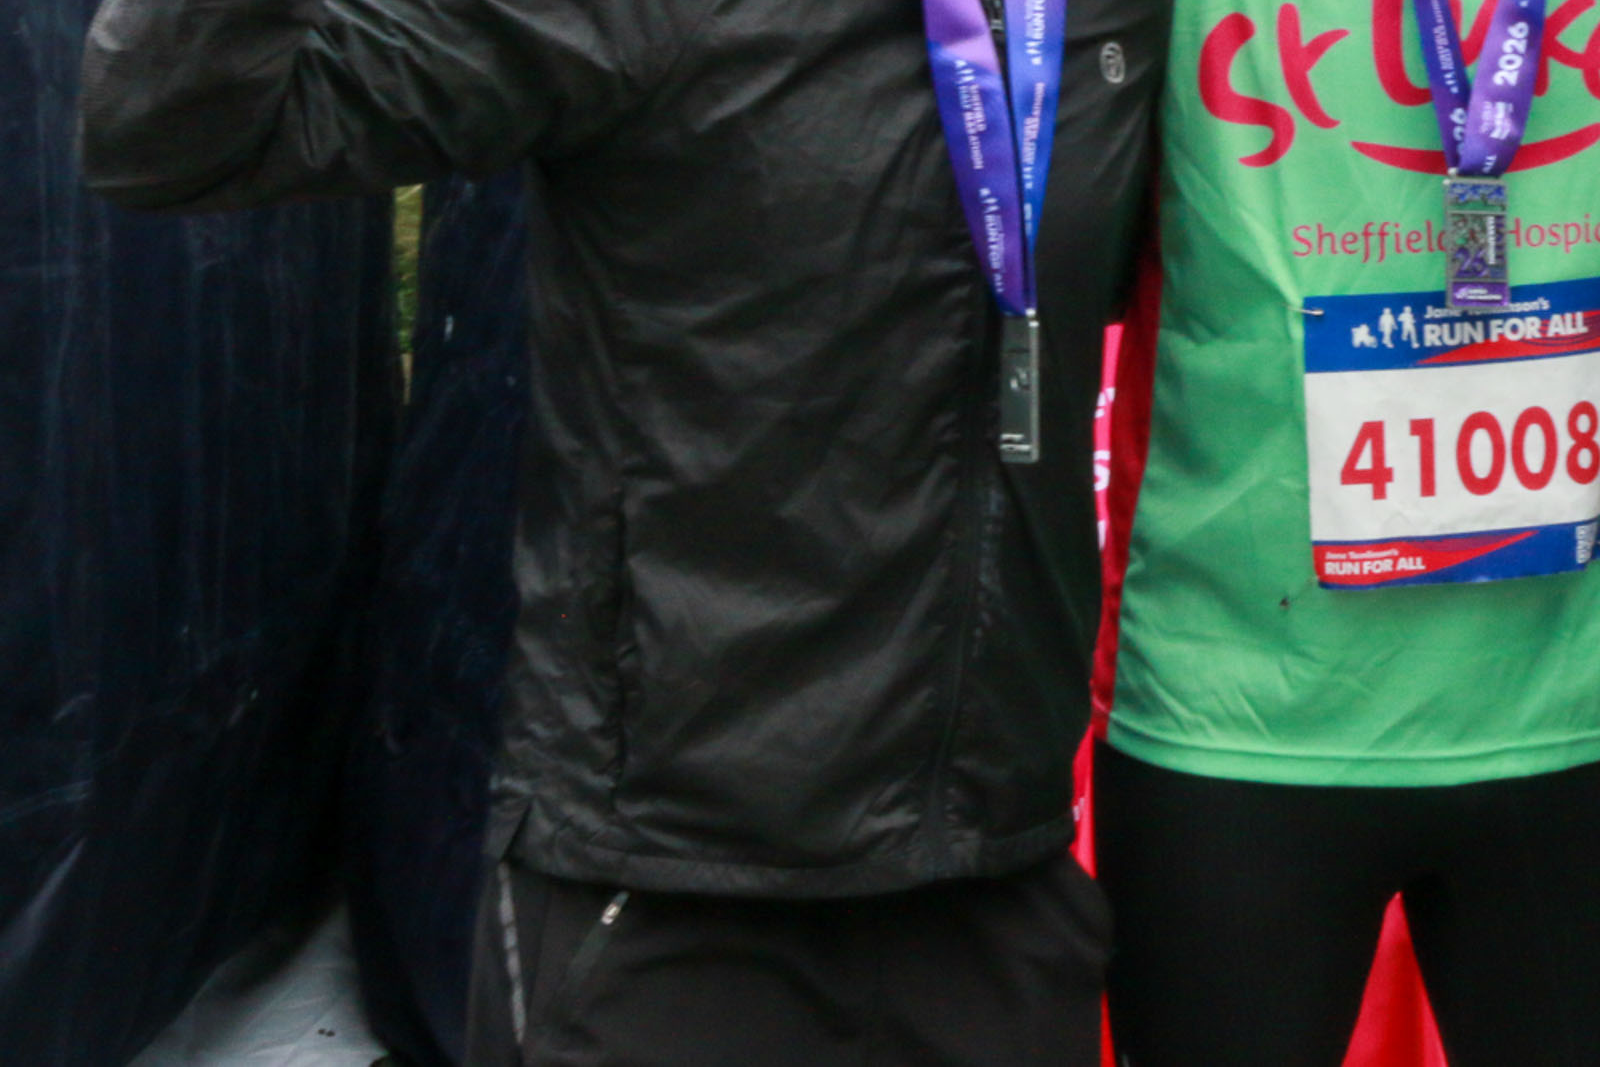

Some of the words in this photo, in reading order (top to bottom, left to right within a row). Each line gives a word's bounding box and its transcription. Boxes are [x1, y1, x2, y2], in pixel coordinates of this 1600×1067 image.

[1493, 21, 1529, 87] 2026
[1198, 3, 1350, 168] St
[1424, 321, 1485, 347] RUN
[1490, 317, 1542, 343] FOR
[1548, 311, 1589, 337] ALL
[1325, 561, 1360, 575] RUN
[1363, 559, 1393, 574] FOR
[1397, 556, 1426, 570] ALL
